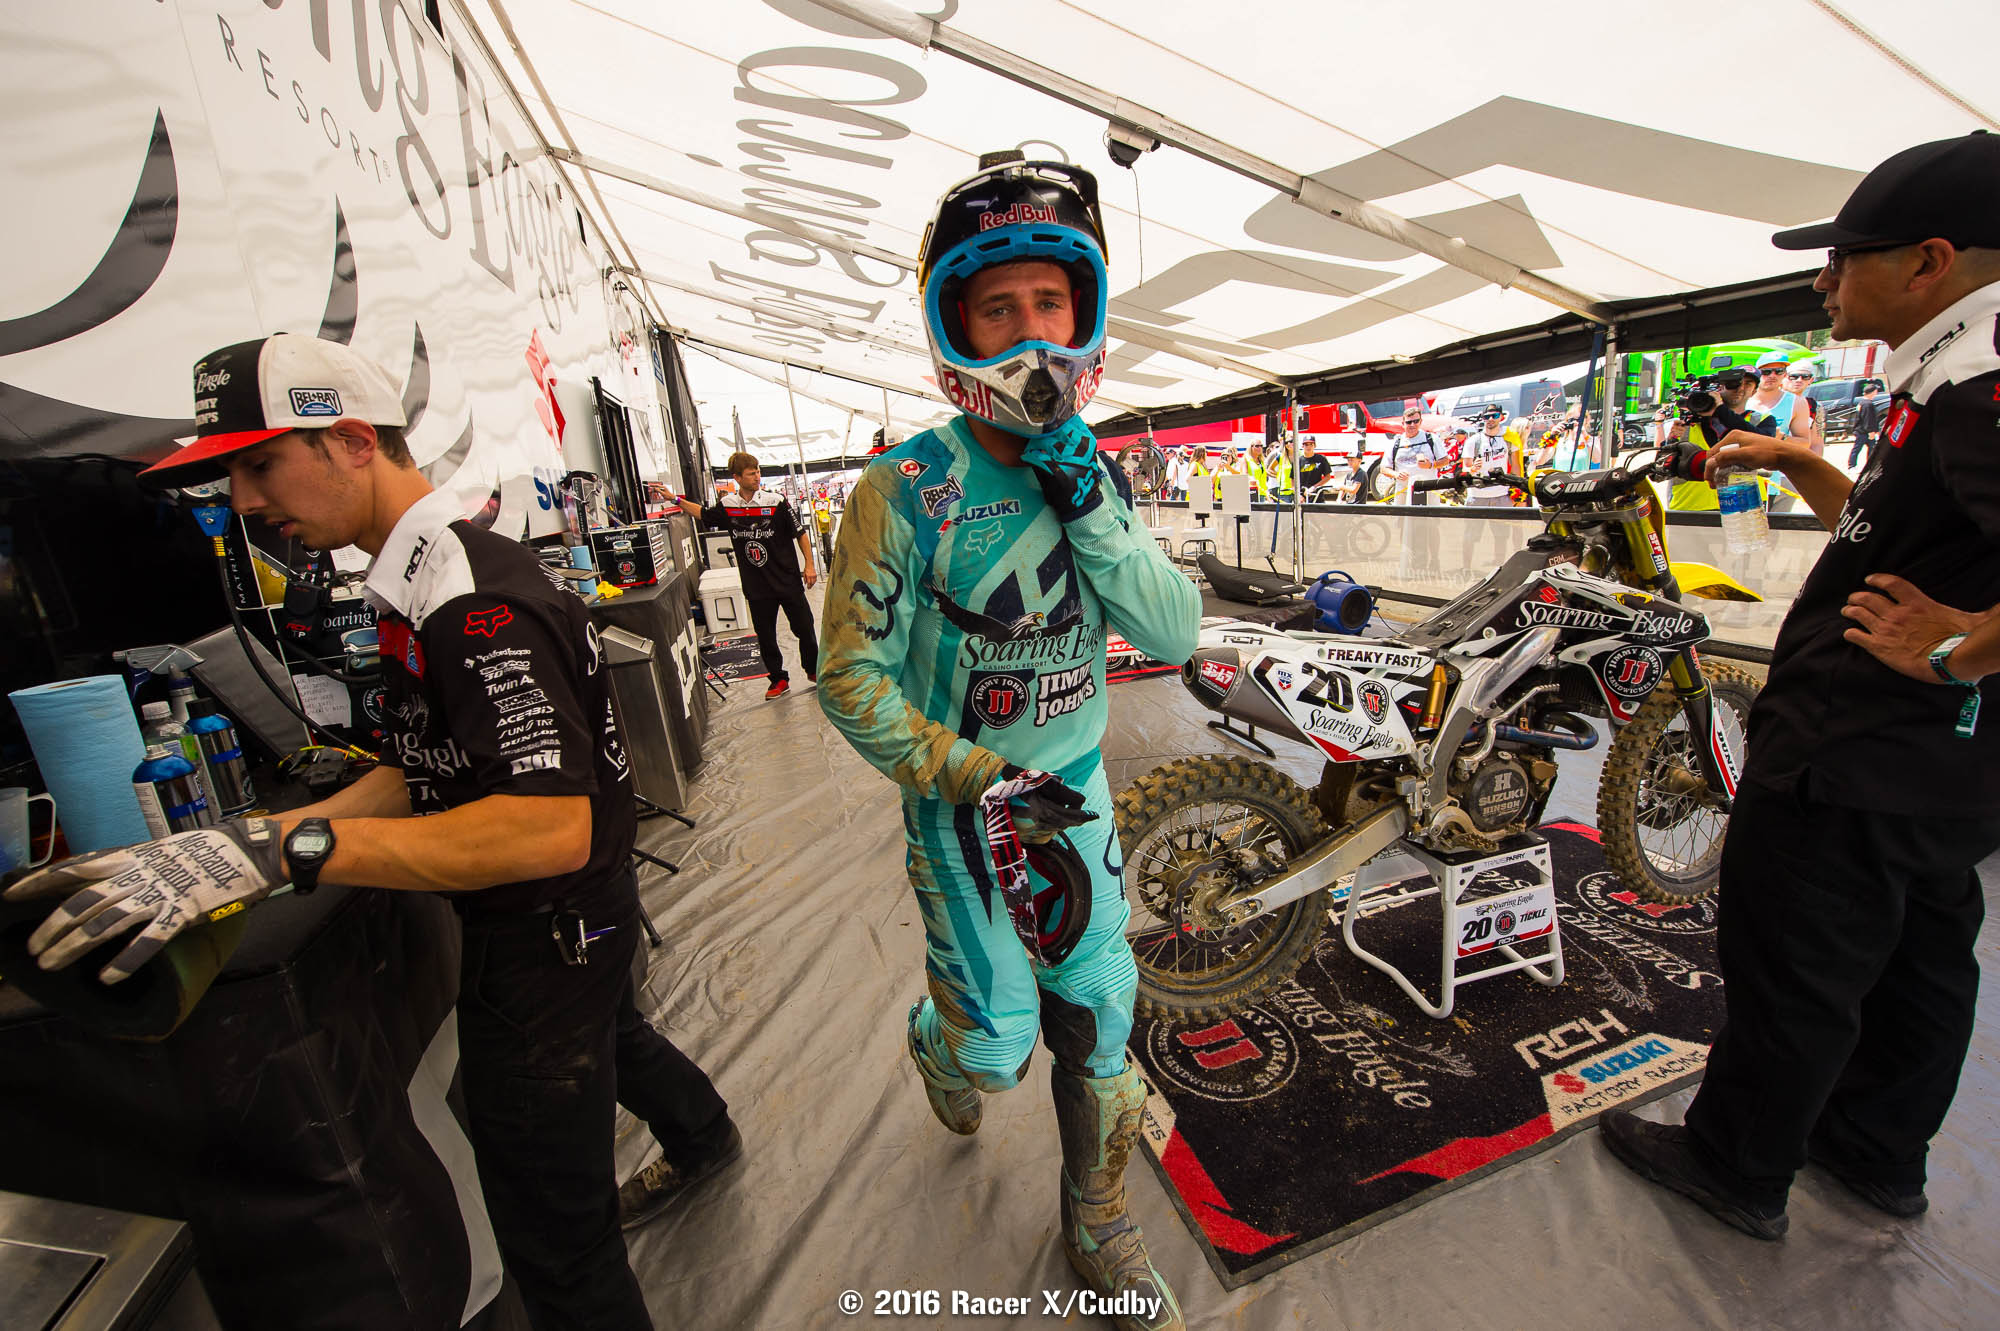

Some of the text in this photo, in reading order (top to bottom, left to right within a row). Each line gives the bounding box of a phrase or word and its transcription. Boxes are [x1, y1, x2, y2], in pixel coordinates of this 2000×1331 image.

[217, 13, 382, 185] RESORT
[979, 203, 1057, 232] Red Bull
[1919, 321, 1965, 364] RCH
[944, 370, 995, 421] Bull
[952, 500, 1020, 526] SUZUKI
[404, 535, 428, 583] RCH
[322, 613, 373, 634] oaring
[1515, 600, 1693, 640] Soaring Eagle
[959, 631, 1070, 669] Soaring
[1069, 624, 1105, 662] Eag
[1222, 635, 1264, 646] RCH
[1327, 648, 1422, 669] FREAKY FAST!
[1609, 648, 1660, 675] JIMMY JOHN'S
[1618, 658, 1649, 685] JJ
[486, 679, 518, 696] Twin
[975, 678, 1025, 700] JIMMY JOHN'S
[1296, 661, 1354, 714] 20
[1608, 676, 1652, 694] SANDWICHES
[987, 689, 1014, 715] JJ
[1036, 678, 1095, 725] JOHN'S
[500, 729, 559, 750] DUNLOP
[1303, 708, 1363, 743] Soaring
[1360, 724, 1393, 751] Eagle
[1478, 788, 1525, 806] SUZUKI
[125, 842, 201, 897] Mechanix
[166, 832, 243, 890] Mechanix
[1519, 908, 1547, 923] TICKLE
[1462, 917, 1492, 945] 20
[1513, 1008, 1630, 1070] RCH
[1580, 1038, 1673, 1084] SUZUKI
[1560, 1049, 1707, 1117] FACTORY RACING
